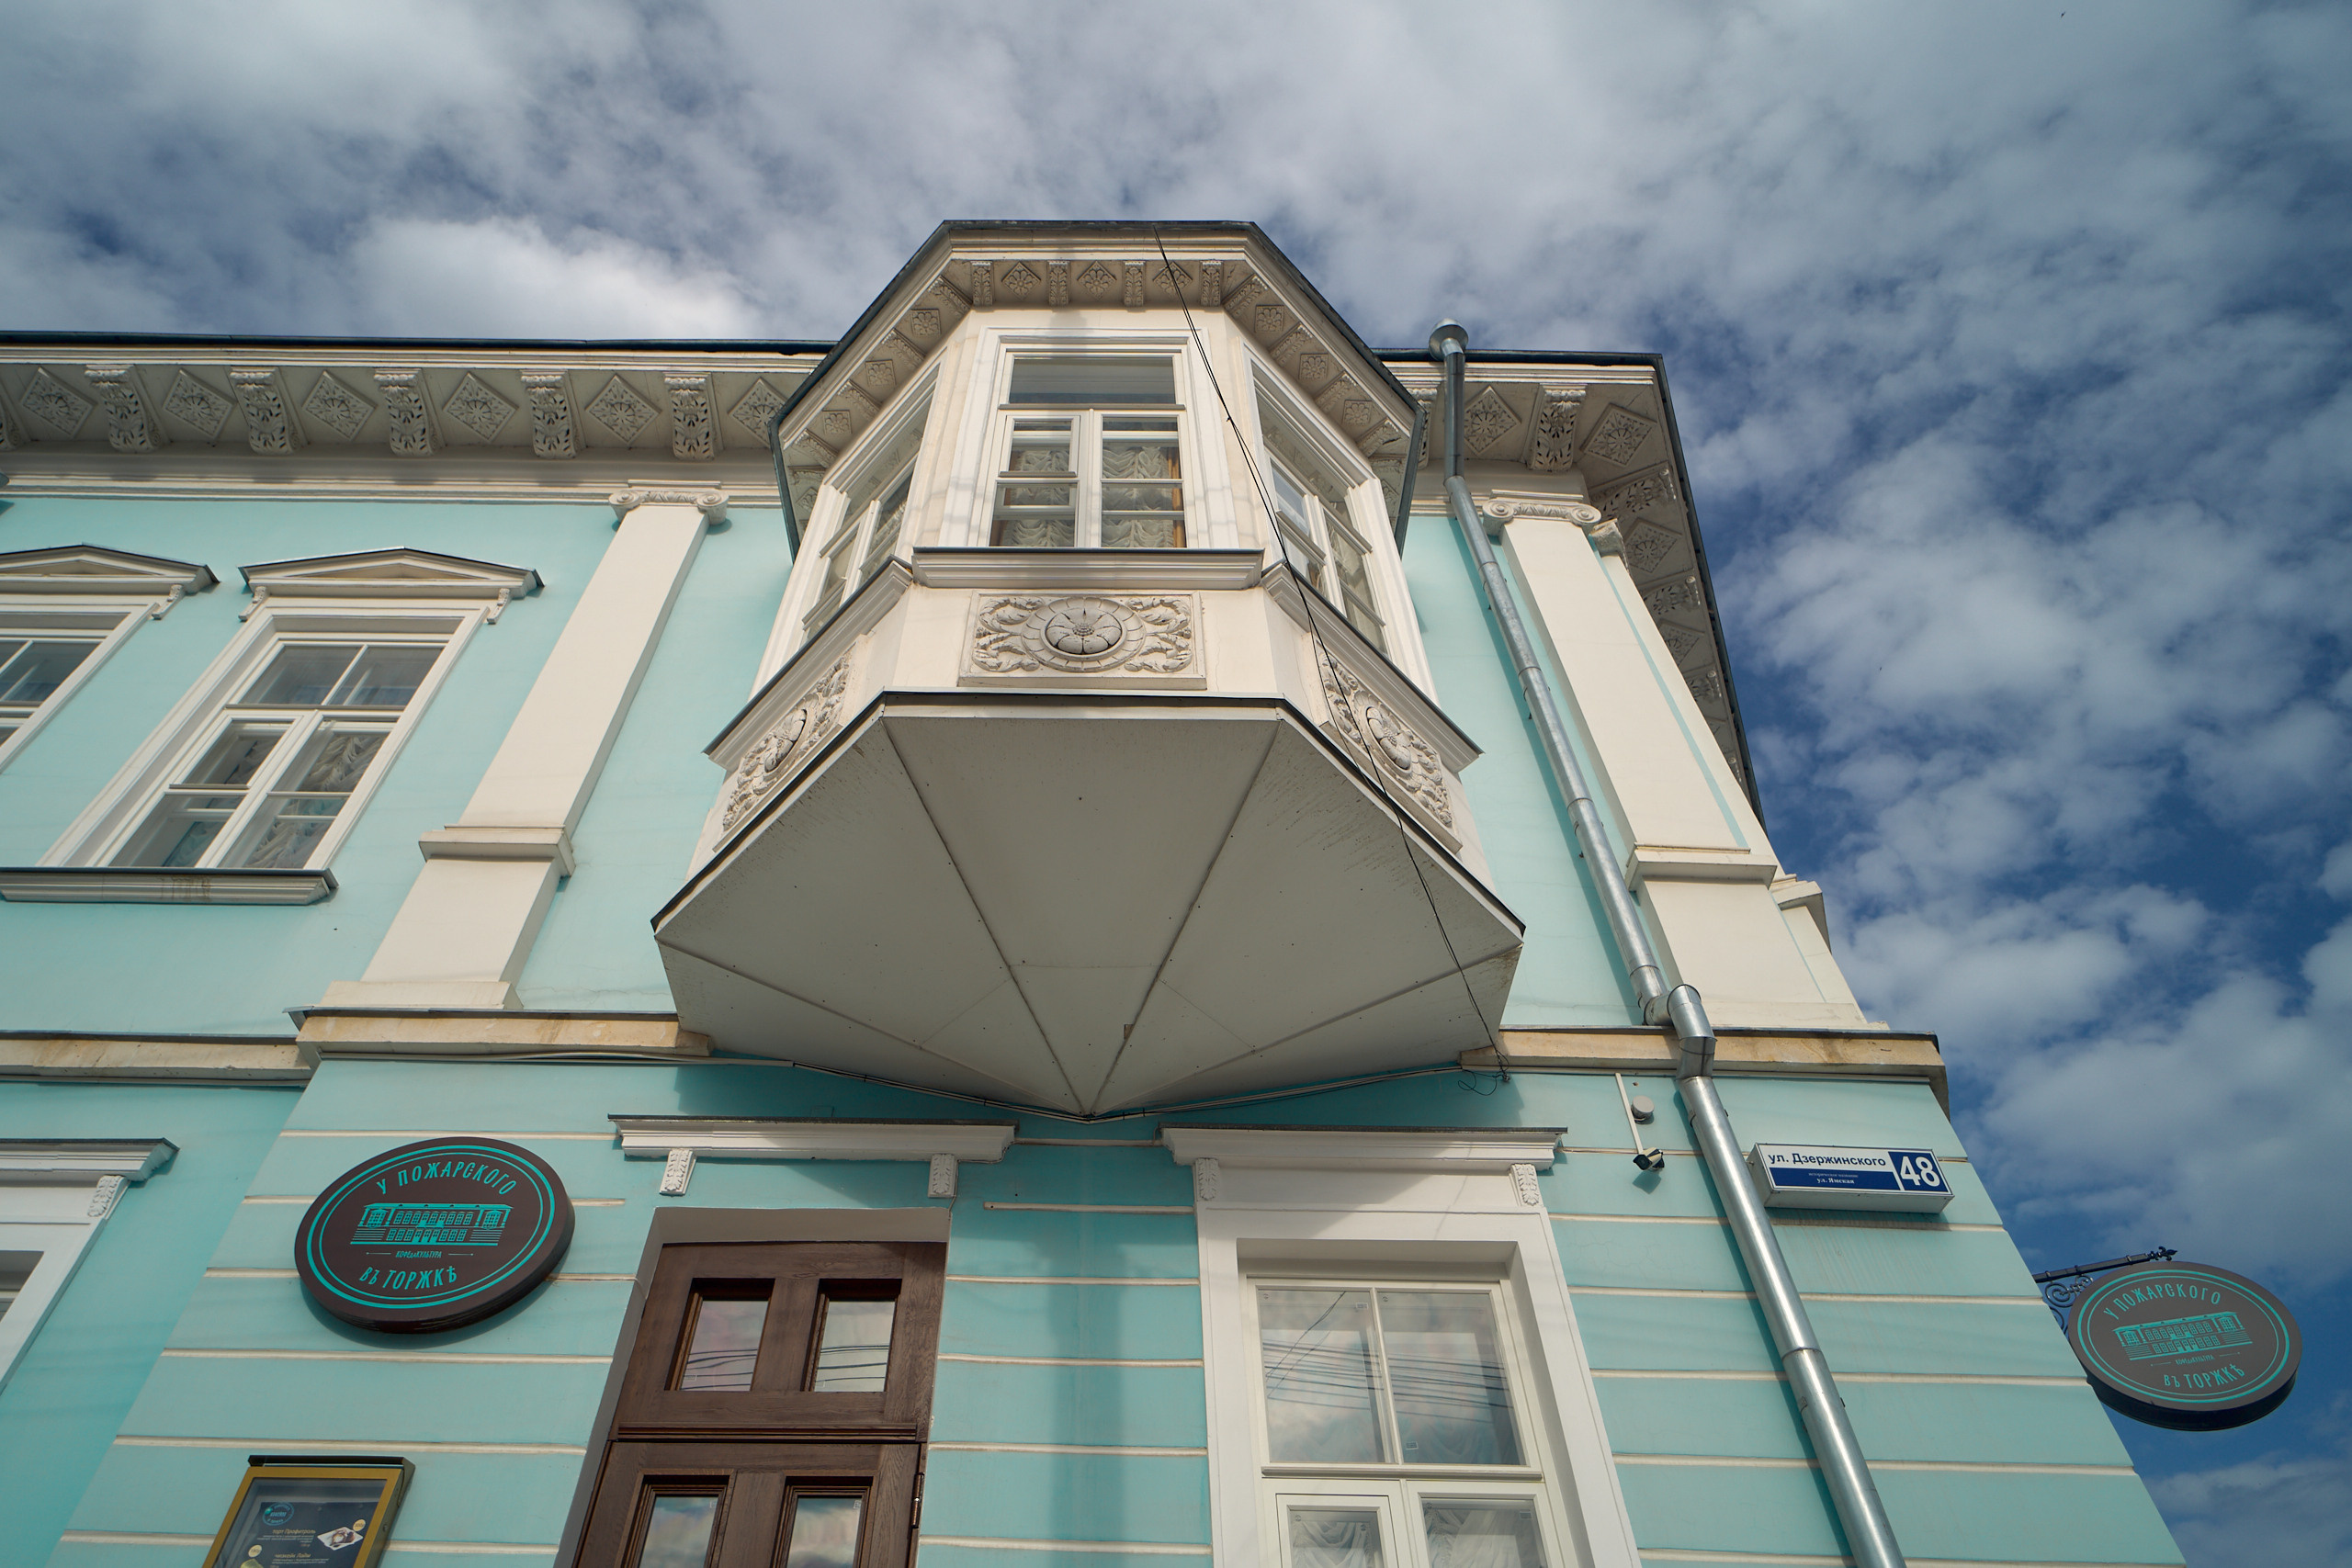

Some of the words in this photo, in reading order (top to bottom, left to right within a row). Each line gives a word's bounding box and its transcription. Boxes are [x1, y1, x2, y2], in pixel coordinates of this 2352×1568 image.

[1768, 1153, 1789, 1165] ул.
[1792, 1153, 1886, 1167] Дзержинского
[1899, 1156, 1940, 1187] 48
[376, 1179, 387, 1195] У
[398, 1161, 517, 1195] ПОЖАРСКОГО
[2103, 1307, 2119, 1320] У
[2113, 1283, 2221, 1312] ПОЖАРСКОГО
